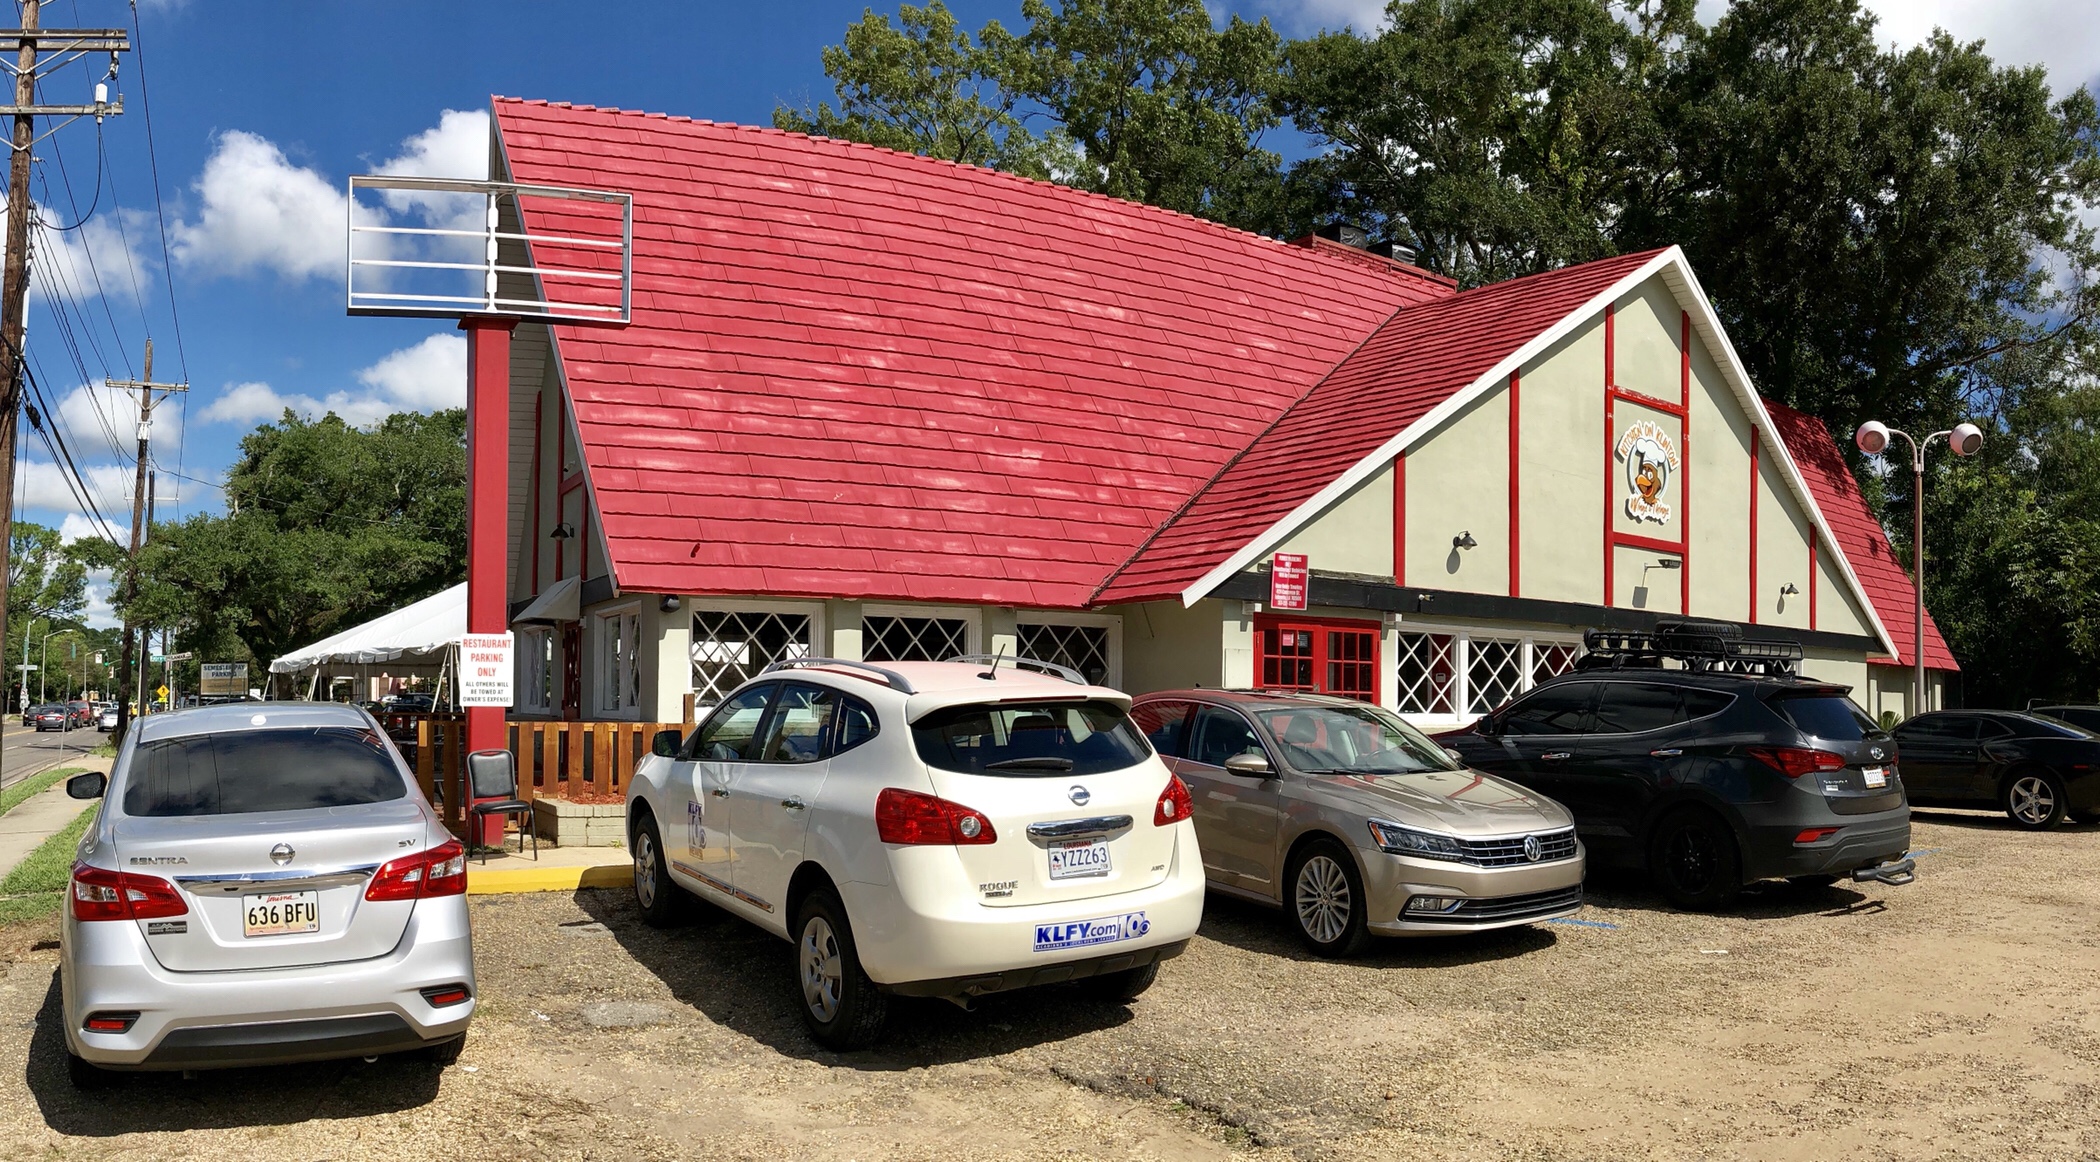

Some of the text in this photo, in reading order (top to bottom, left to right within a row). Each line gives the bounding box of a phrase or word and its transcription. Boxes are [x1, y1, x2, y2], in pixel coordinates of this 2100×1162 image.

[1619, 421, 1679, 466] KITCHEN ON KLINTON
[463, 639, 511, 648] RESTAURANT
[471, 653, 503, 662] PARKING
[478, 667, 496, 676] ONLY
[398, 839, 416, 848] SV
[1063, 840, 1092, 850] LOUISIANA
[130, 857, 189, 865] SENTRA
[1061, 847, 1107, 867] YZZ263
[979, 881, 1018, 892] ROGUE
[248, 903, 315, 926] 636 BFU
[1036, 922, 1116, 943] KLFY.com
[1036, 941, 1068, 950] ACADIANA'S
